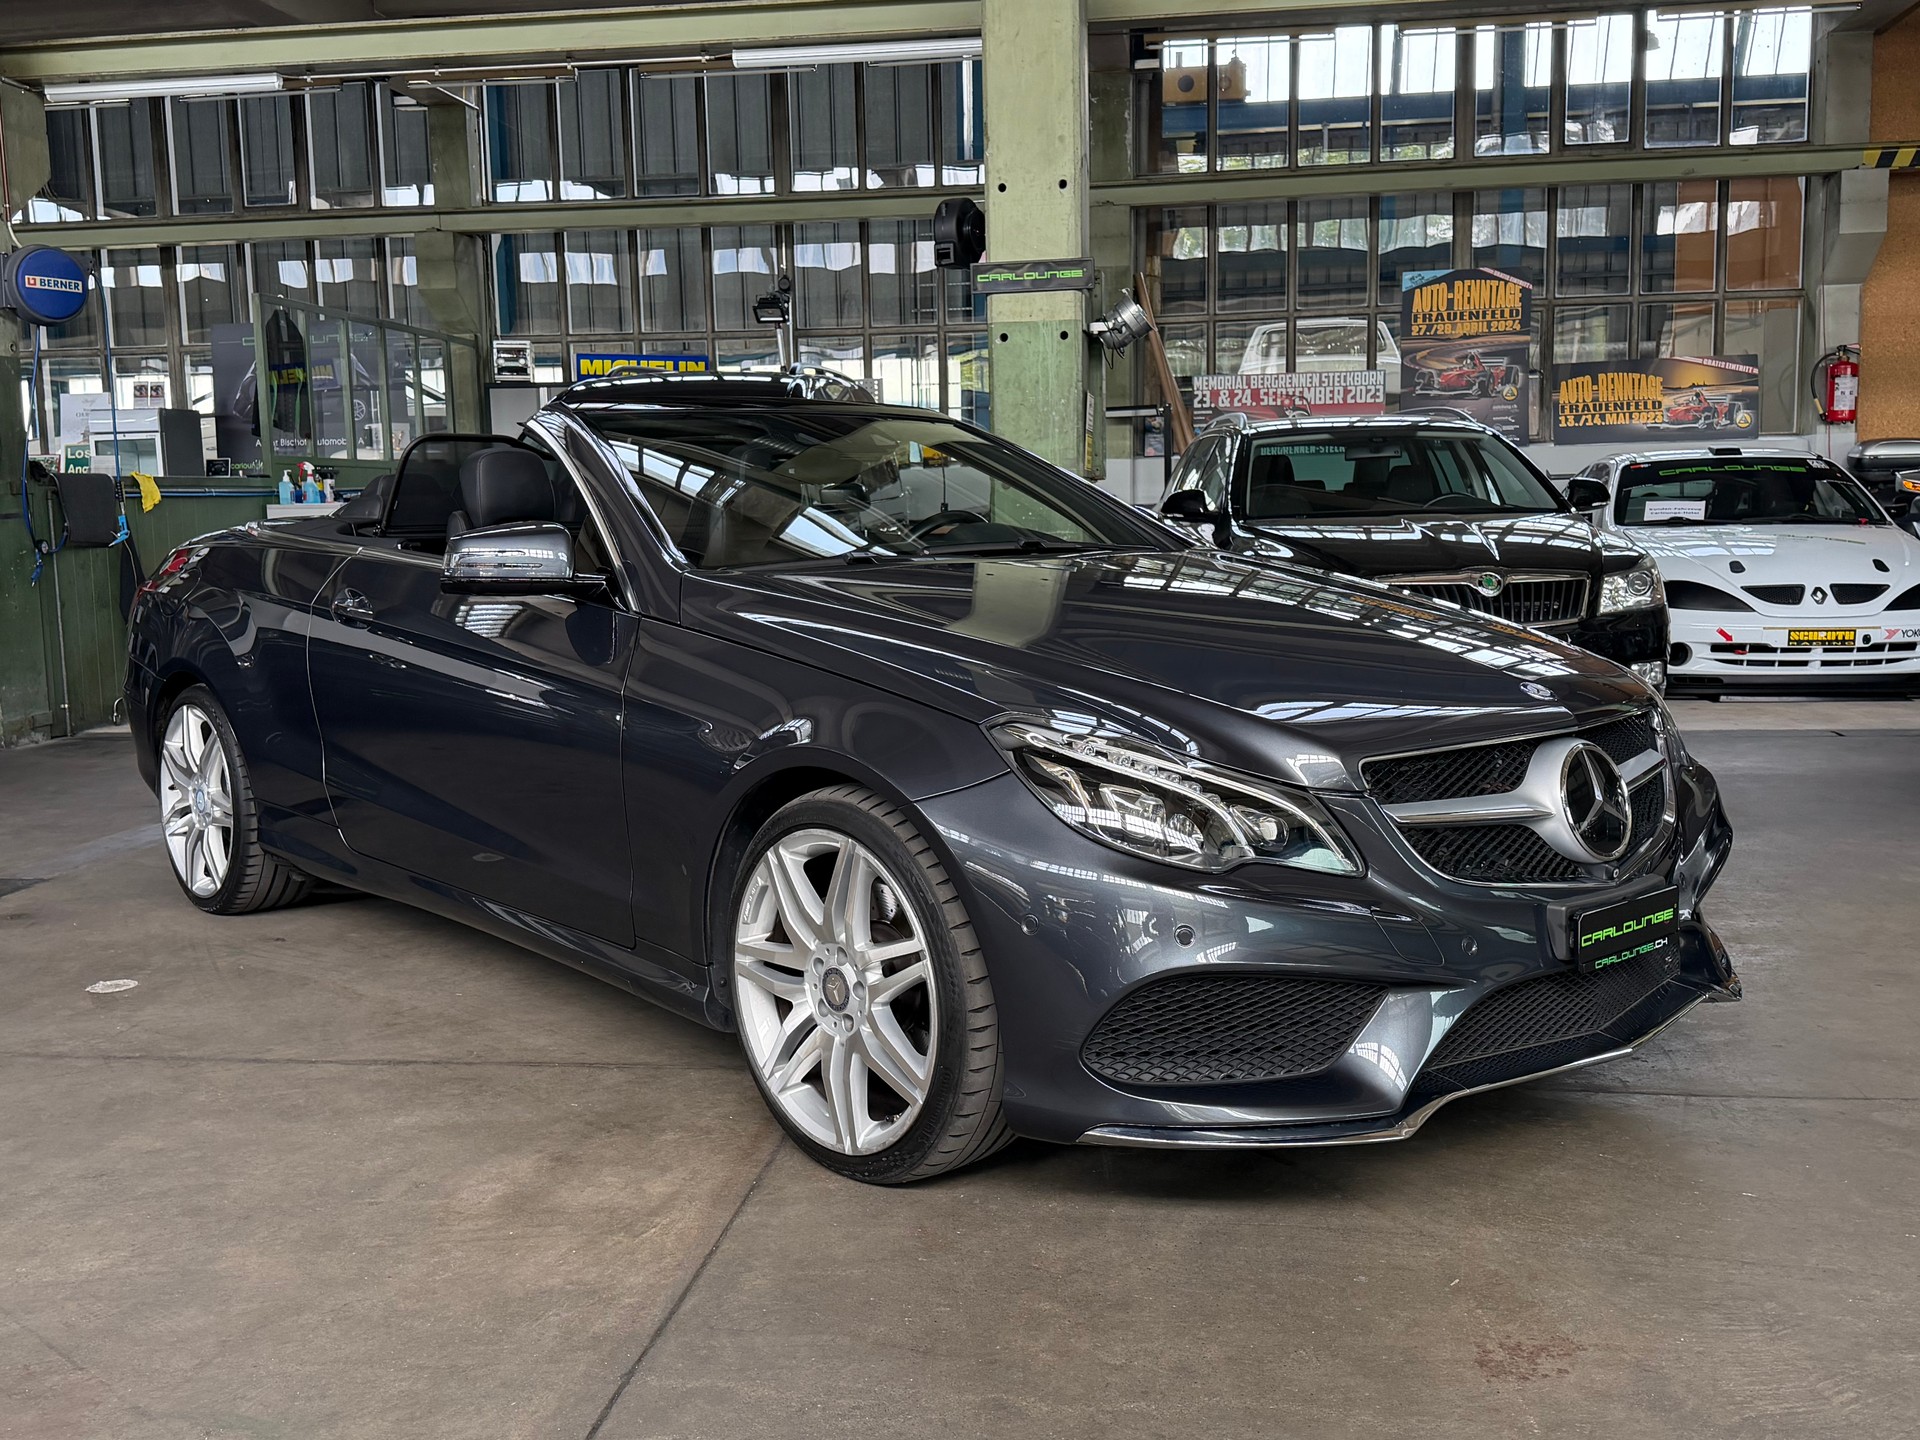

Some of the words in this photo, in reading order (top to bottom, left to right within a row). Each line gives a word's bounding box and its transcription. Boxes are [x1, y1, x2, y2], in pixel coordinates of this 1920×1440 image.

[977, 270, 1083, 282] CARLOUNGE
[40, 278, 81, 291] BERNER
[1412, 279, 1522, 312] AUTO-RENNTAGE
[1412, 308, 1521, 323] FRAUENFELD
[1490, 320, 1521, 332] 2024
[1193, 376, 1249, 390] MEMORIAL
[1251, 373, 1320, 389] BERGRENNEN
[1322, 371, 1385, 387] STECKBORN
[1559, 373, 1664, 404] AUTO-RENNTAGE
[1193, 390, 1215, 408] 23.
[1218, 391, 1231, 407] &
[1233, 390, 1257, 406] 24.
[1347, 385, 1385, 404] 2023
[1560, 400, 1663, 414] FRAUENFELD
[1632, 411, 1664, 425] 2023
[1658, 464, 1807, 476] CARLOUNGE
[1789, 631, 1855, 640] SCHROTH
[1581, 908, 1674, 947] CARLOUNGE
[1594, 937, 1669, 969] CARLOUNGE.CH
